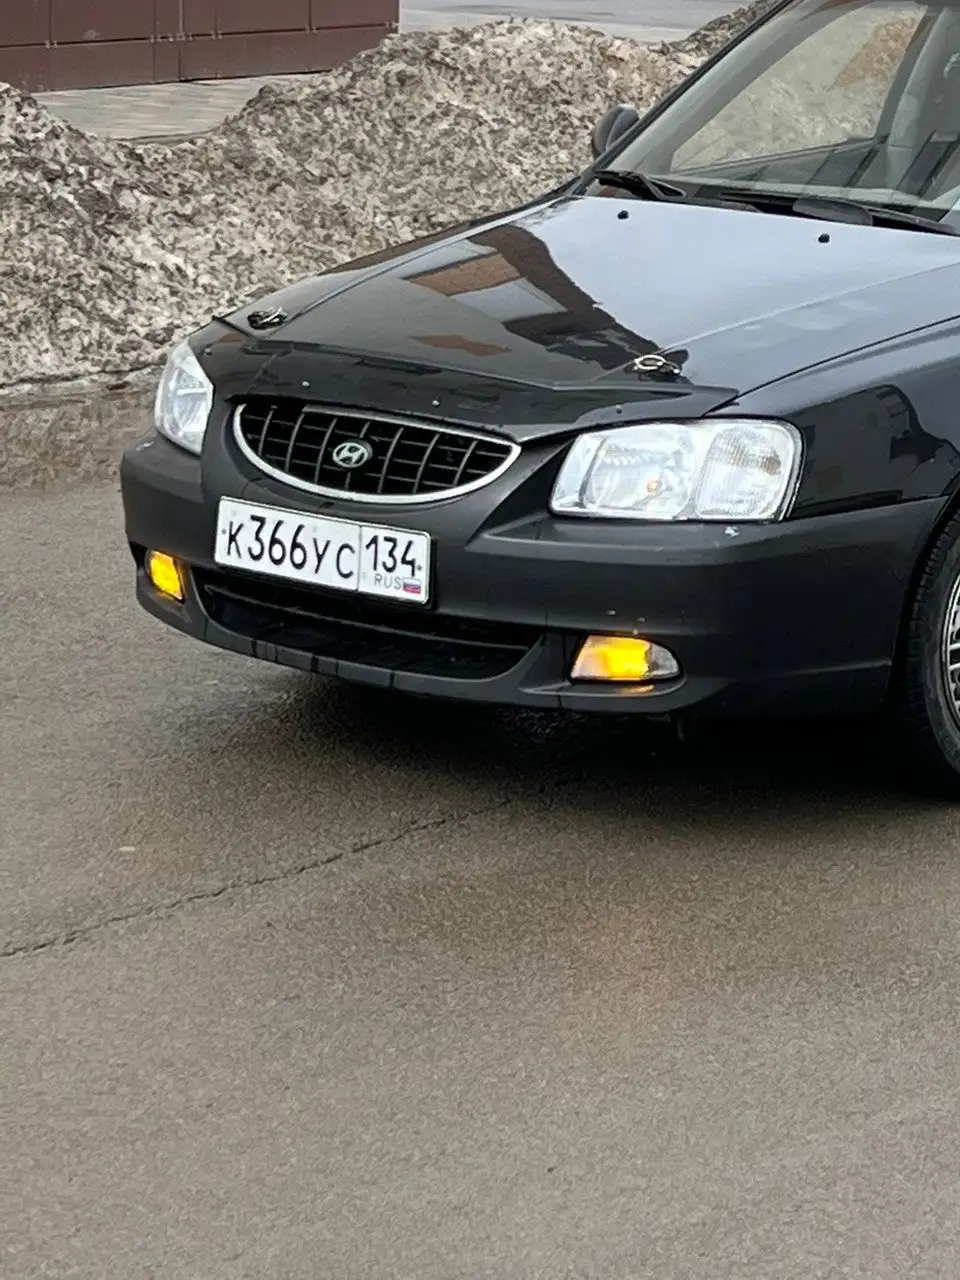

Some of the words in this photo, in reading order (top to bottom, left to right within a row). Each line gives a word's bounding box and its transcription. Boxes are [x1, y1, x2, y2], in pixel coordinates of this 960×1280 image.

[227, 514, 356, 579] К366УС
[366, 535, 417, 577] 134
[374, 573, 402, 590] RUS
